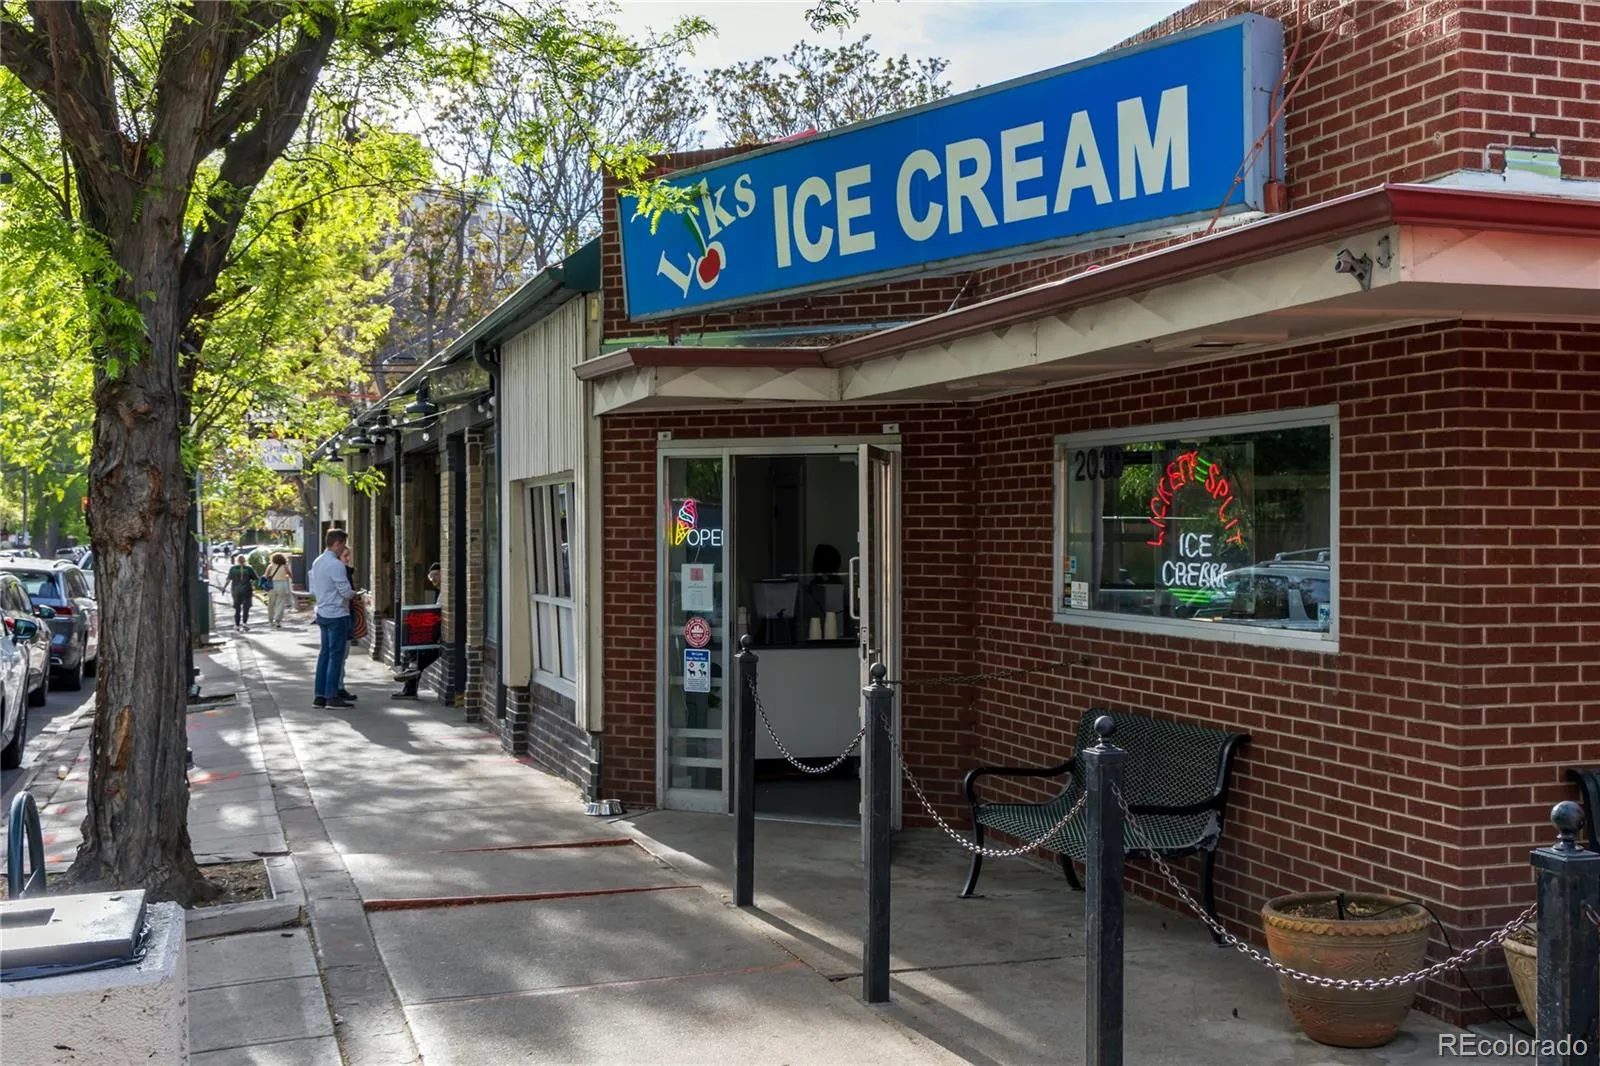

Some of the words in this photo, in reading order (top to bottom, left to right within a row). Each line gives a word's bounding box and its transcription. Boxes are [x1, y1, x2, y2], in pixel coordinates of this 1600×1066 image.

[772, 163, 876, 269] ICE
[896, 84, 1190, 242] CREAM
[1205, 463, 1244, 546] SPLIT
[1178, 532, 1213, 558] ICE
[1161, 560, 1228, 589] CREAM
